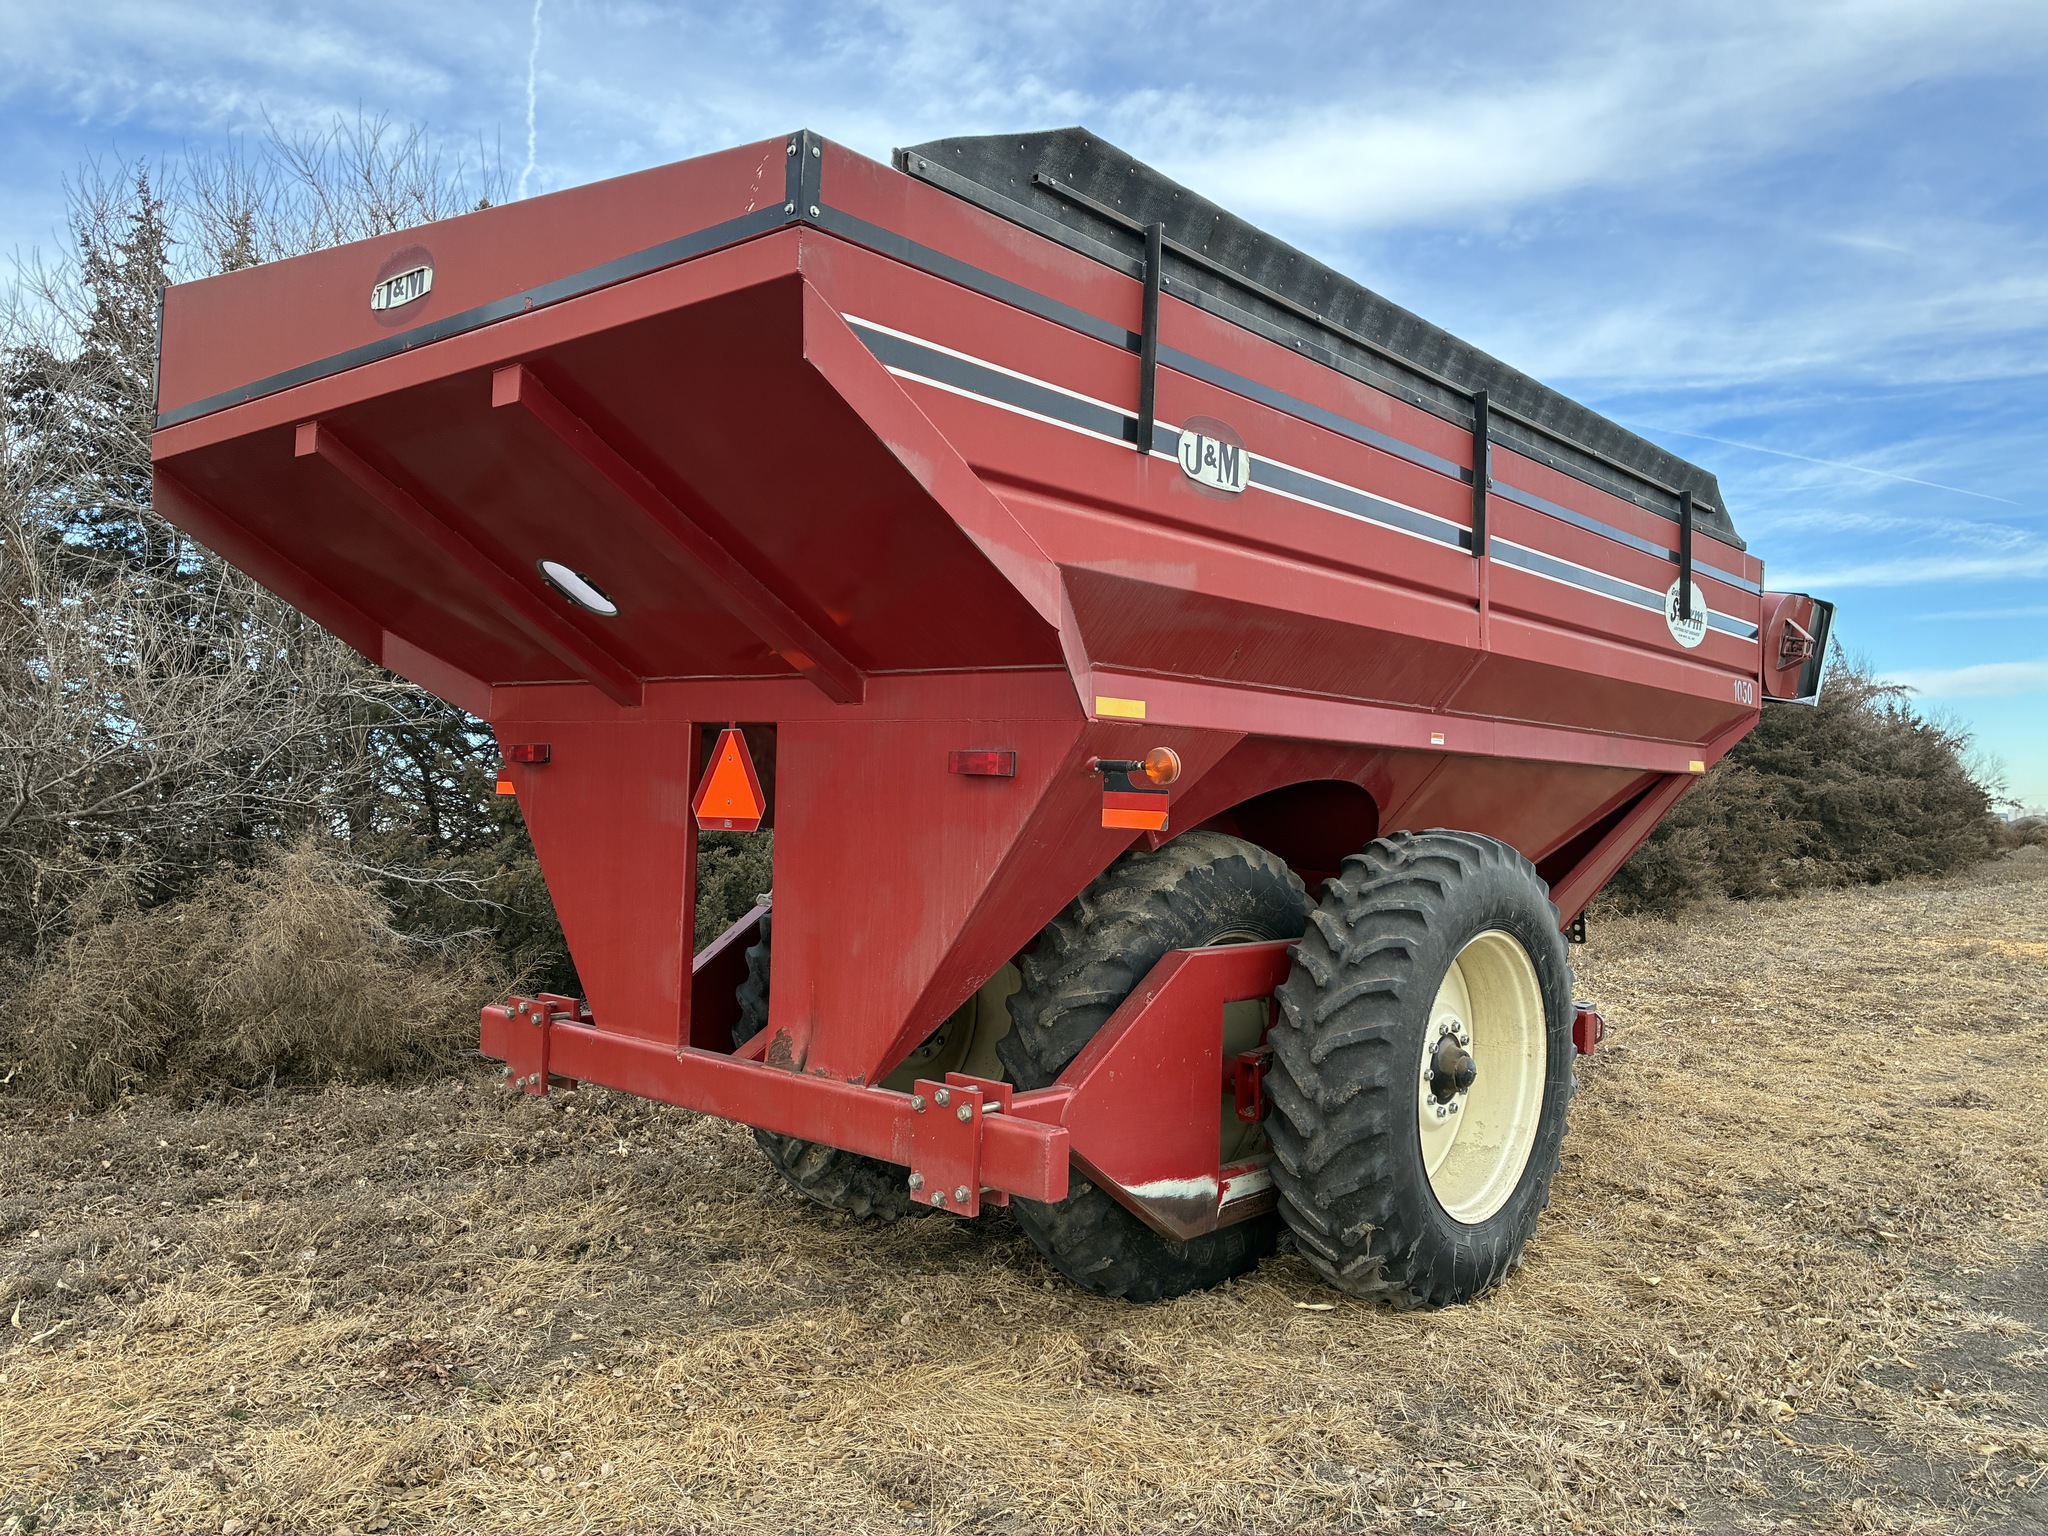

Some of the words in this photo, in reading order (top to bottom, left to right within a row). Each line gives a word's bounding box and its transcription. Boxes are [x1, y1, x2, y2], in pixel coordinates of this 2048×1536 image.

[1184, 434, 1239, 487] J&M
[1670, 597, 1704, 631] Srm
[1734, 679, 1753, 705] 1050
